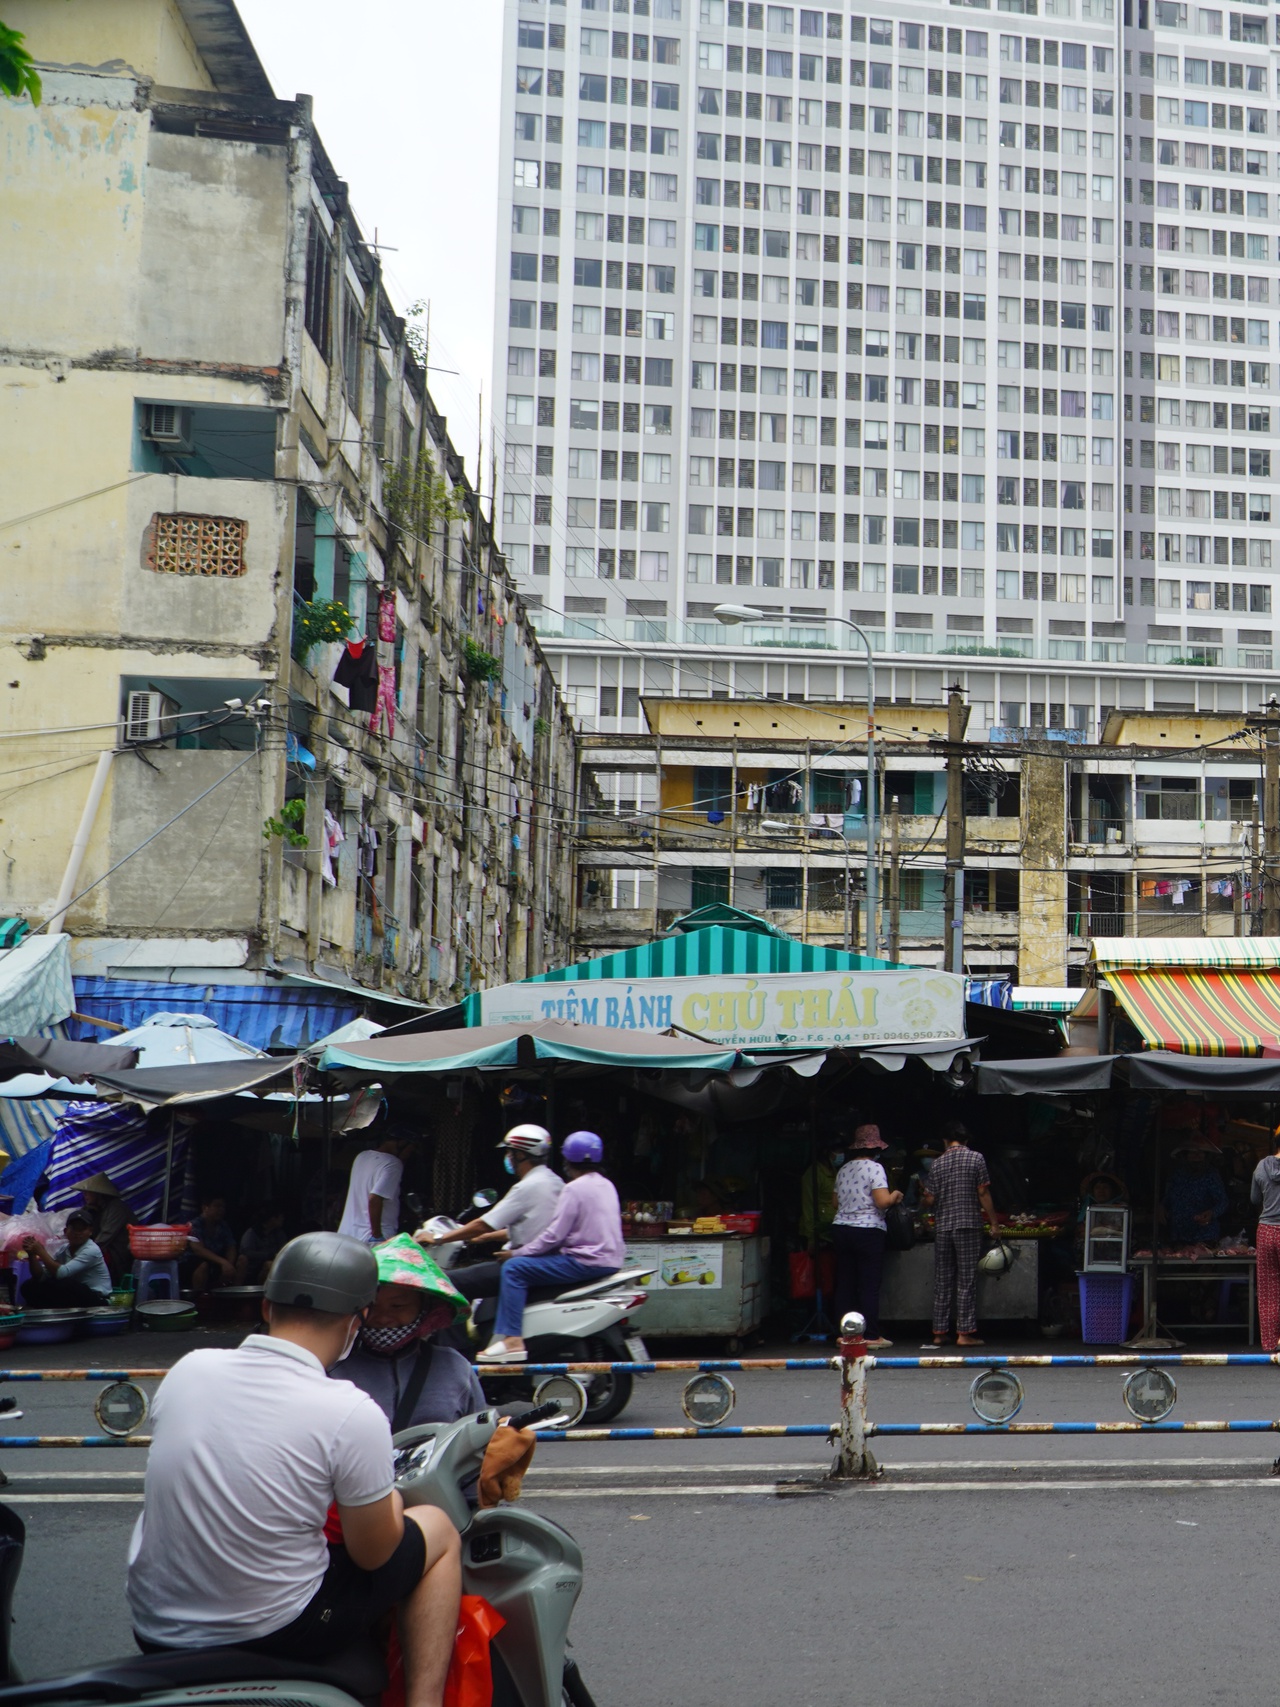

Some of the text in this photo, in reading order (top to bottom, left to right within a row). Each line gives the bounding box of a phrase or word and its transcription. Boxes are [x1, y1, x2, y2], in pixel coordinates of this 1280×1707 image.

[605, 986, 673, 1029] BÁNH
[776, 976, 879, 1029] THÁI
[707, 1034, 746, 1044] GUYỄN
[834, 1034, 851, 1042] Q.4
